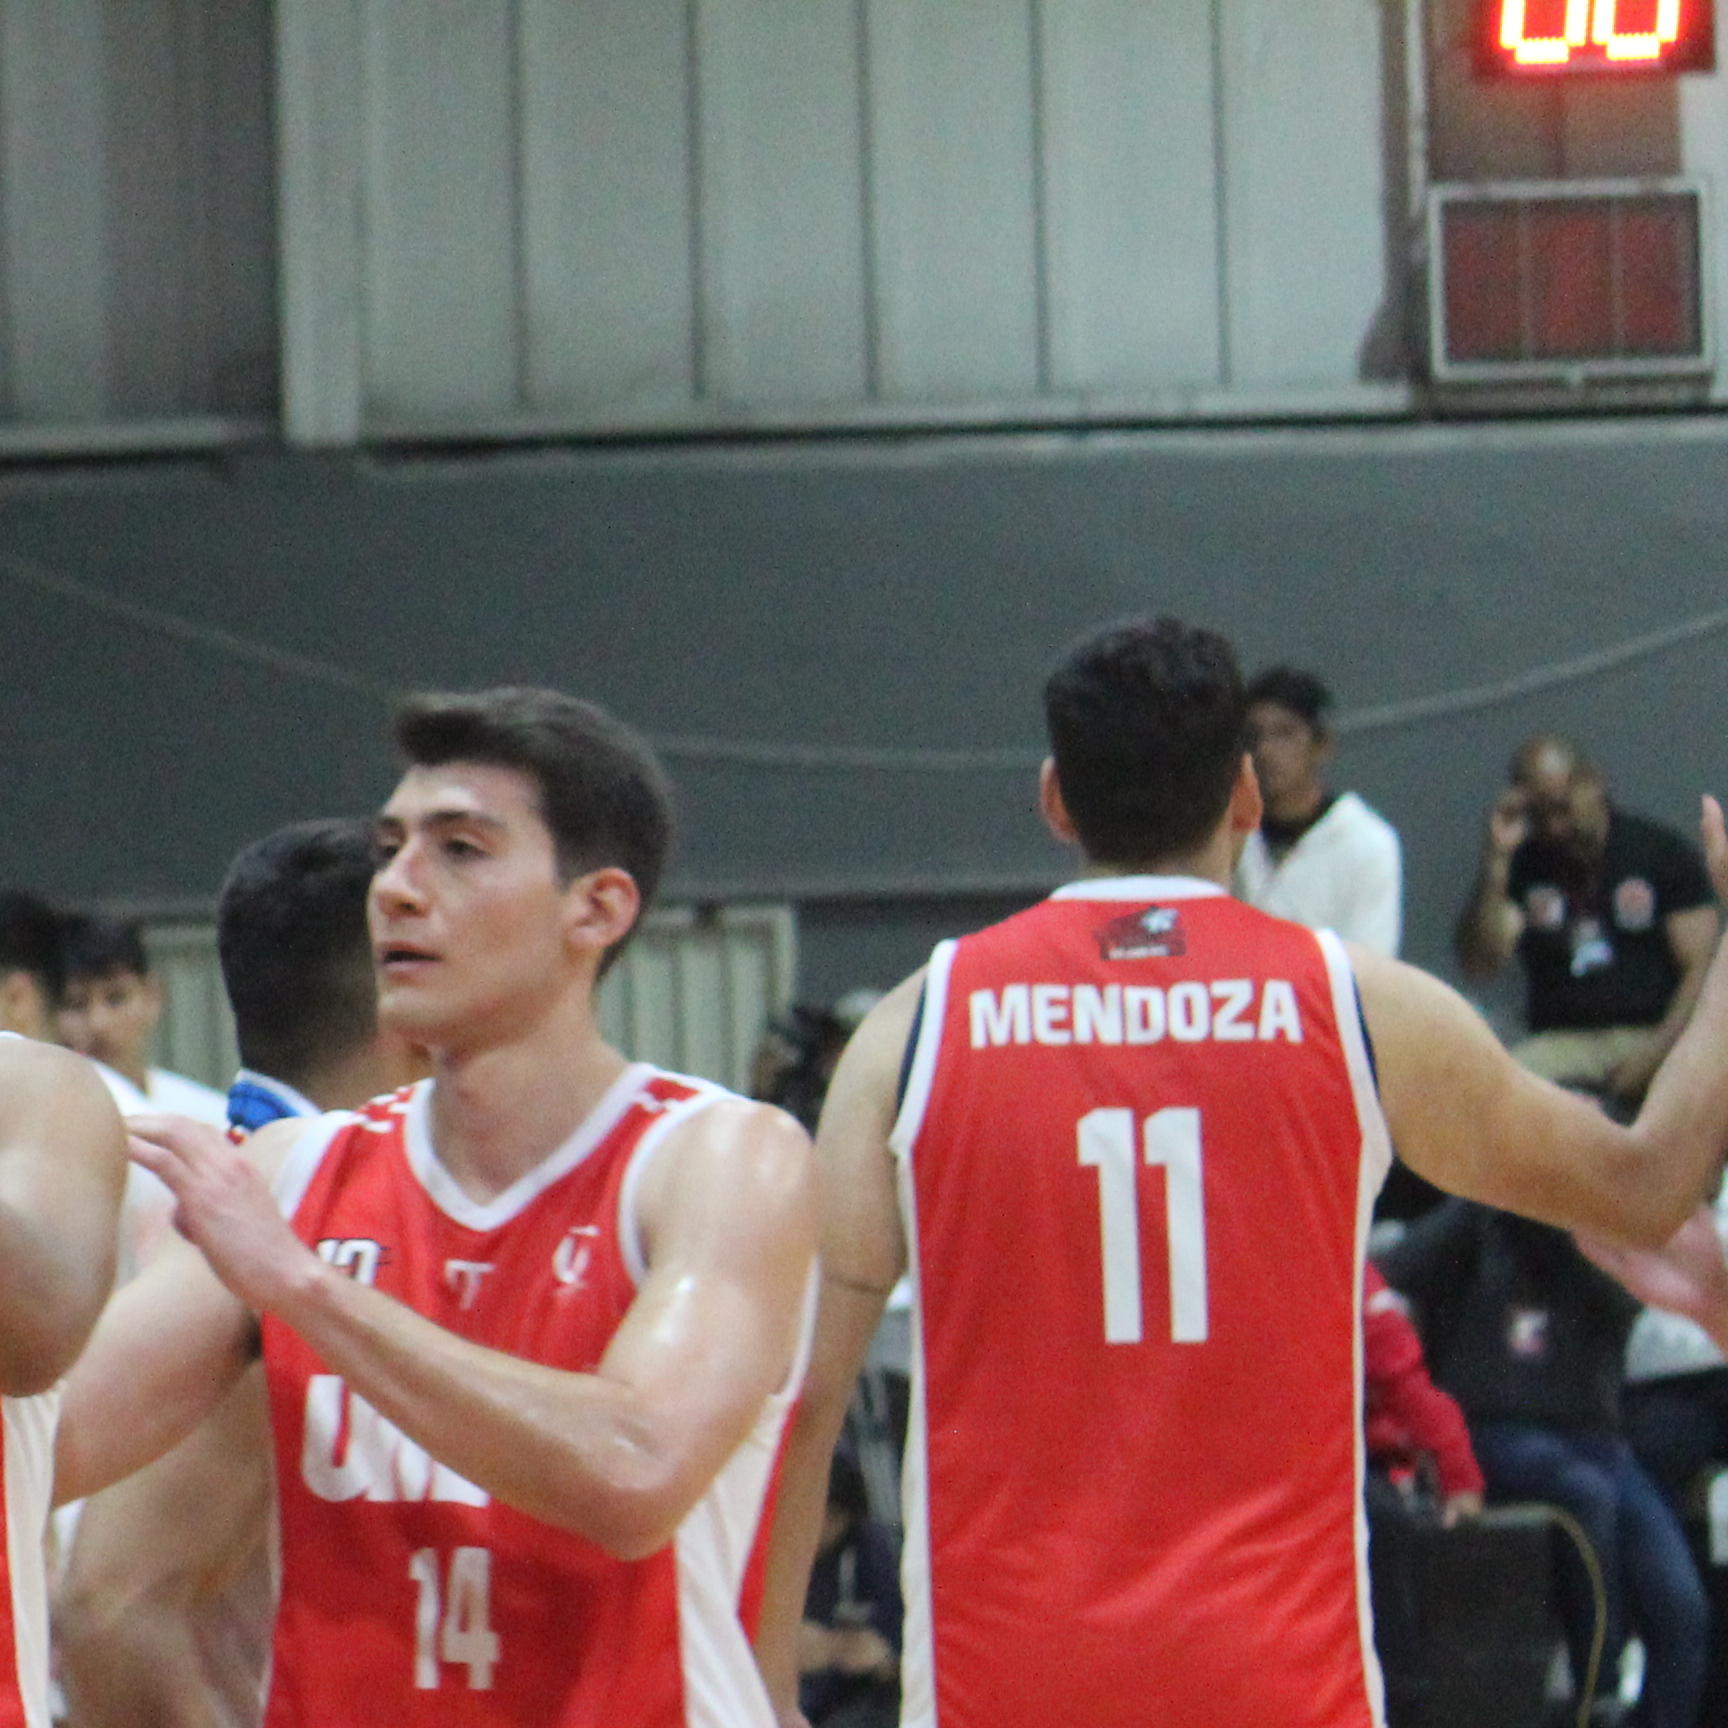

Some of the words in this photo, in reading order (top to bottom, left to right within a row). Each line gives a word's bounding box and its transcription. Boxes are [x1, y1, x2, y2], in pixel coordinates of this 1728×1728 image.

[968, 980, 1302, 1048] MENDOZA
[1075, 1106, 1209, 1345] 11
[408, 1546, 501, 1690] 14
